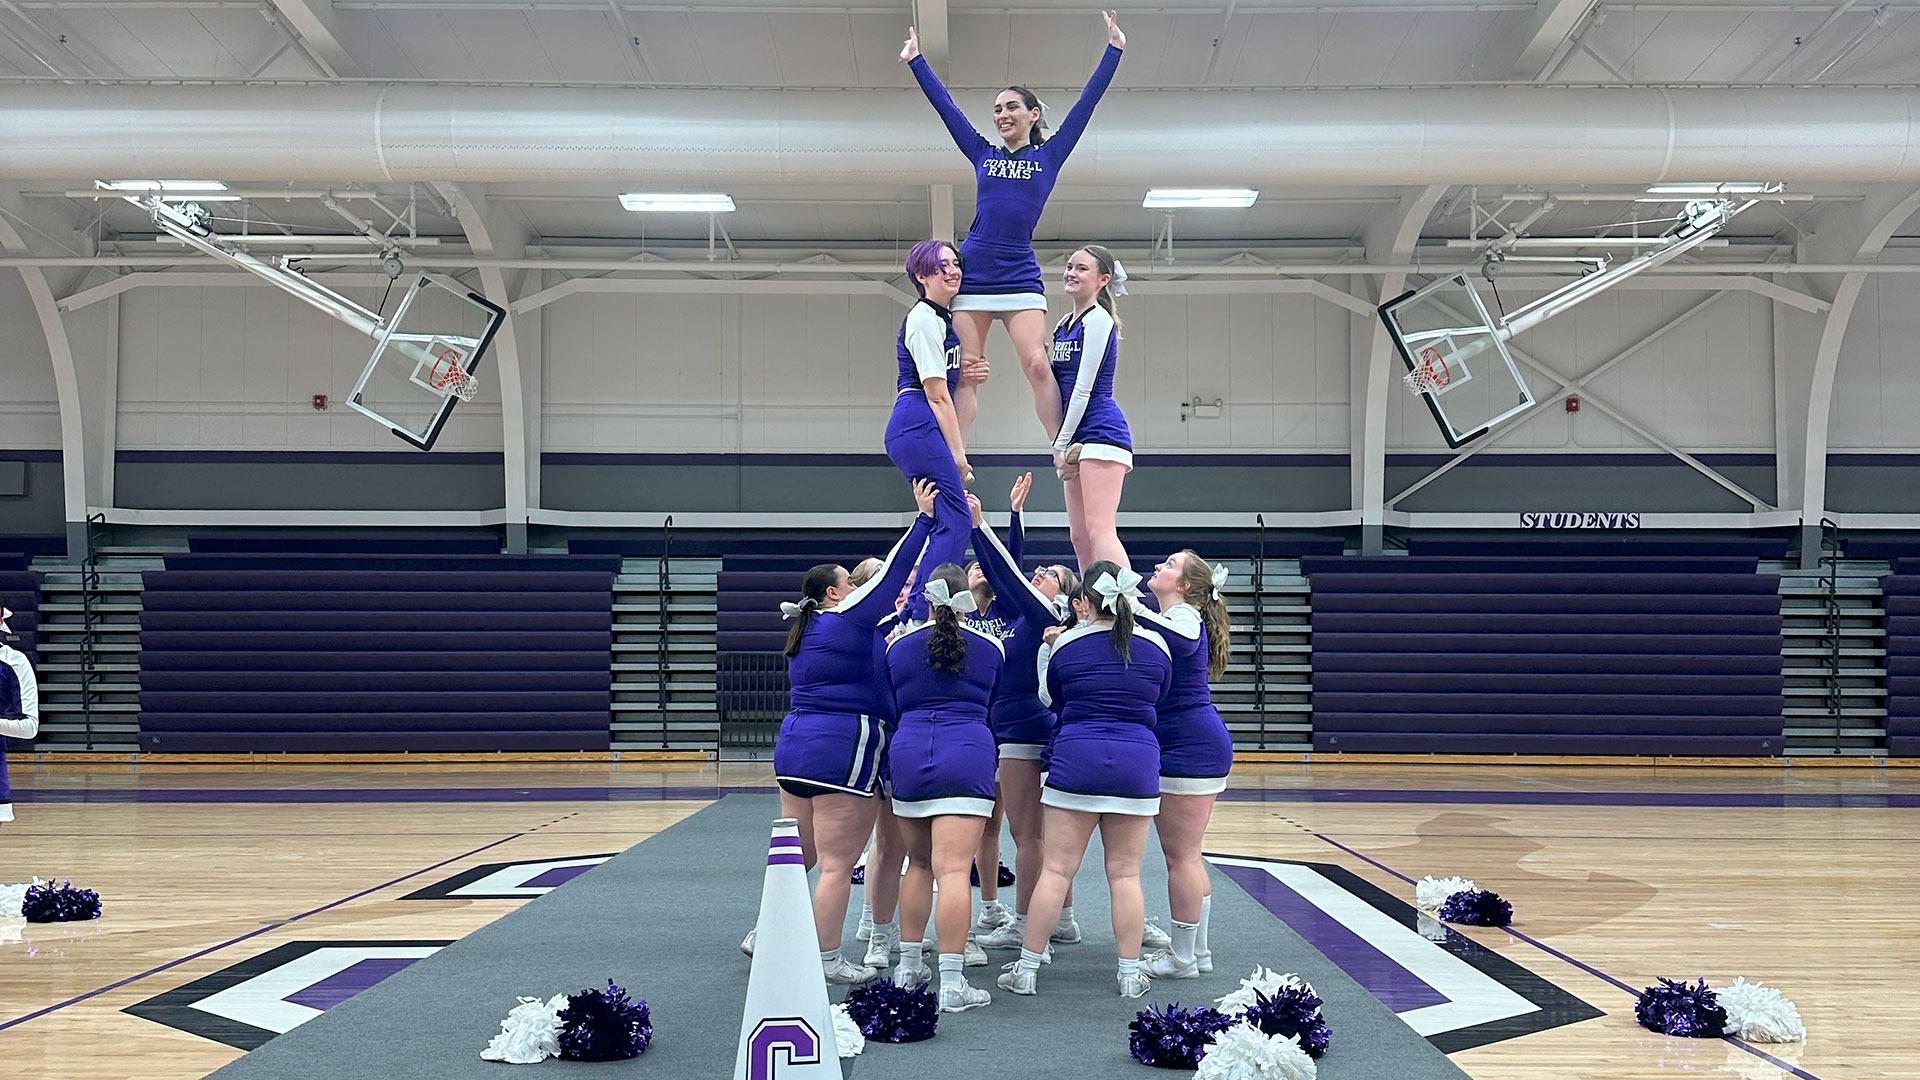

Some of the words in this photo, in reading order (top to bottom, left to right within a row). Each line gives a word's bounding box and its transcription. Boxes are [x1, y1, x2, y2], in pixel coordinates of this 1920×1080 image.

[983, 159, 1042, 172] CORNELL
[987, 166, 1032, 180] RAMS
[1521, 512, 1639, 529] STUDENTS
